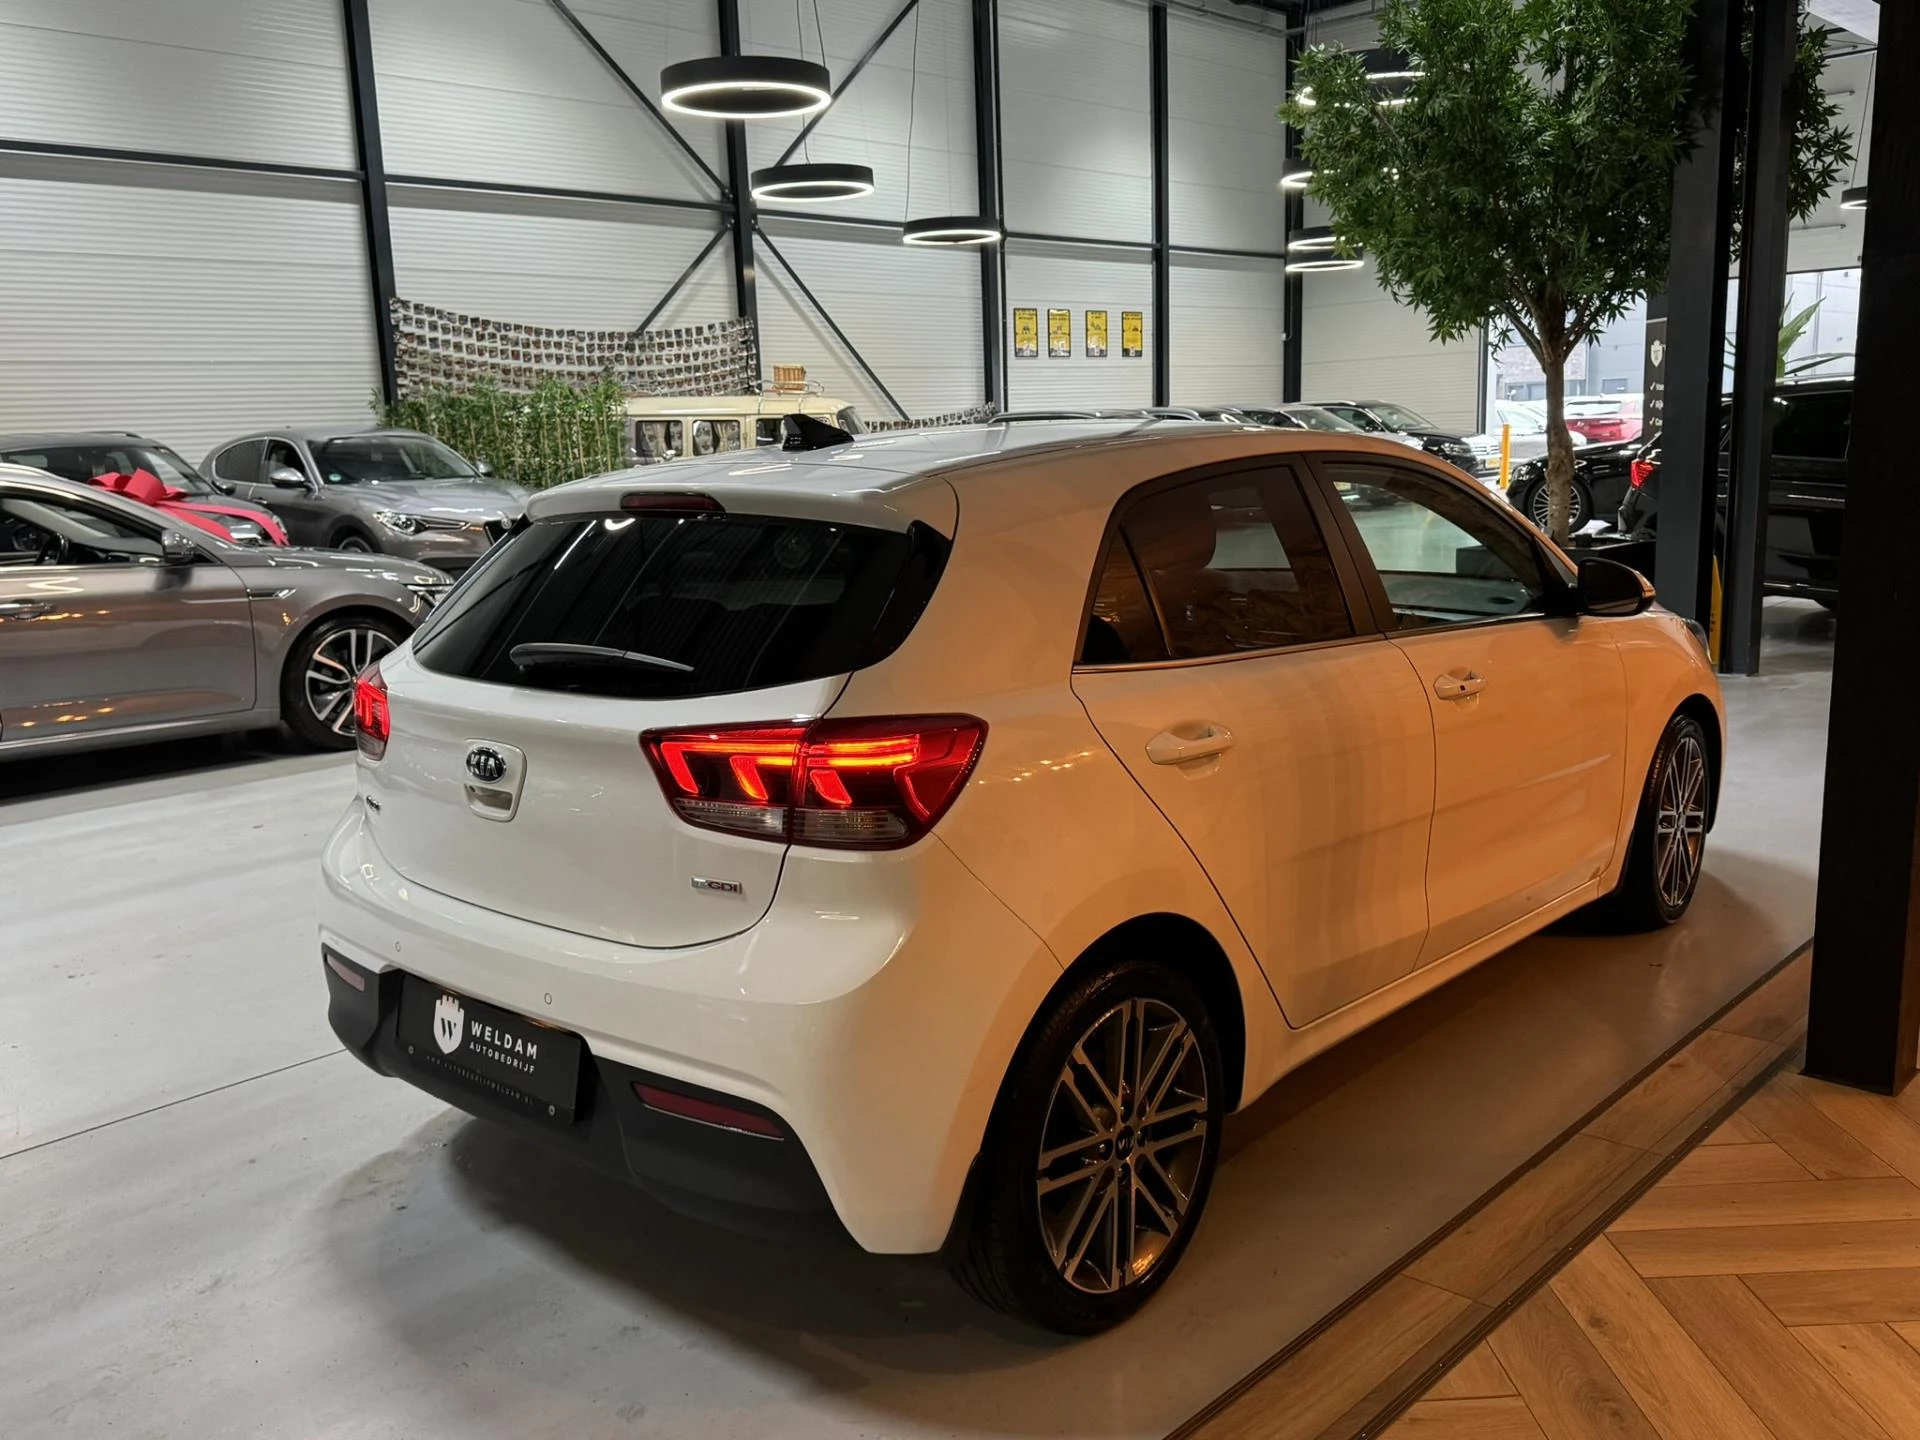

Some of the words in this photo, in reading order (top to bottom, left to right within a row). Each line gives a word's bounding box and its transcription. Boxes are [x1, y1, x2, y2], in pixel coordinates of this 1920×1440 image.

[469, 752, 499, 778] KIA
[471, 1020, 538, 1060] WELDAM
[469, 1041, 535, 1074] AUTOBEDRIJF
